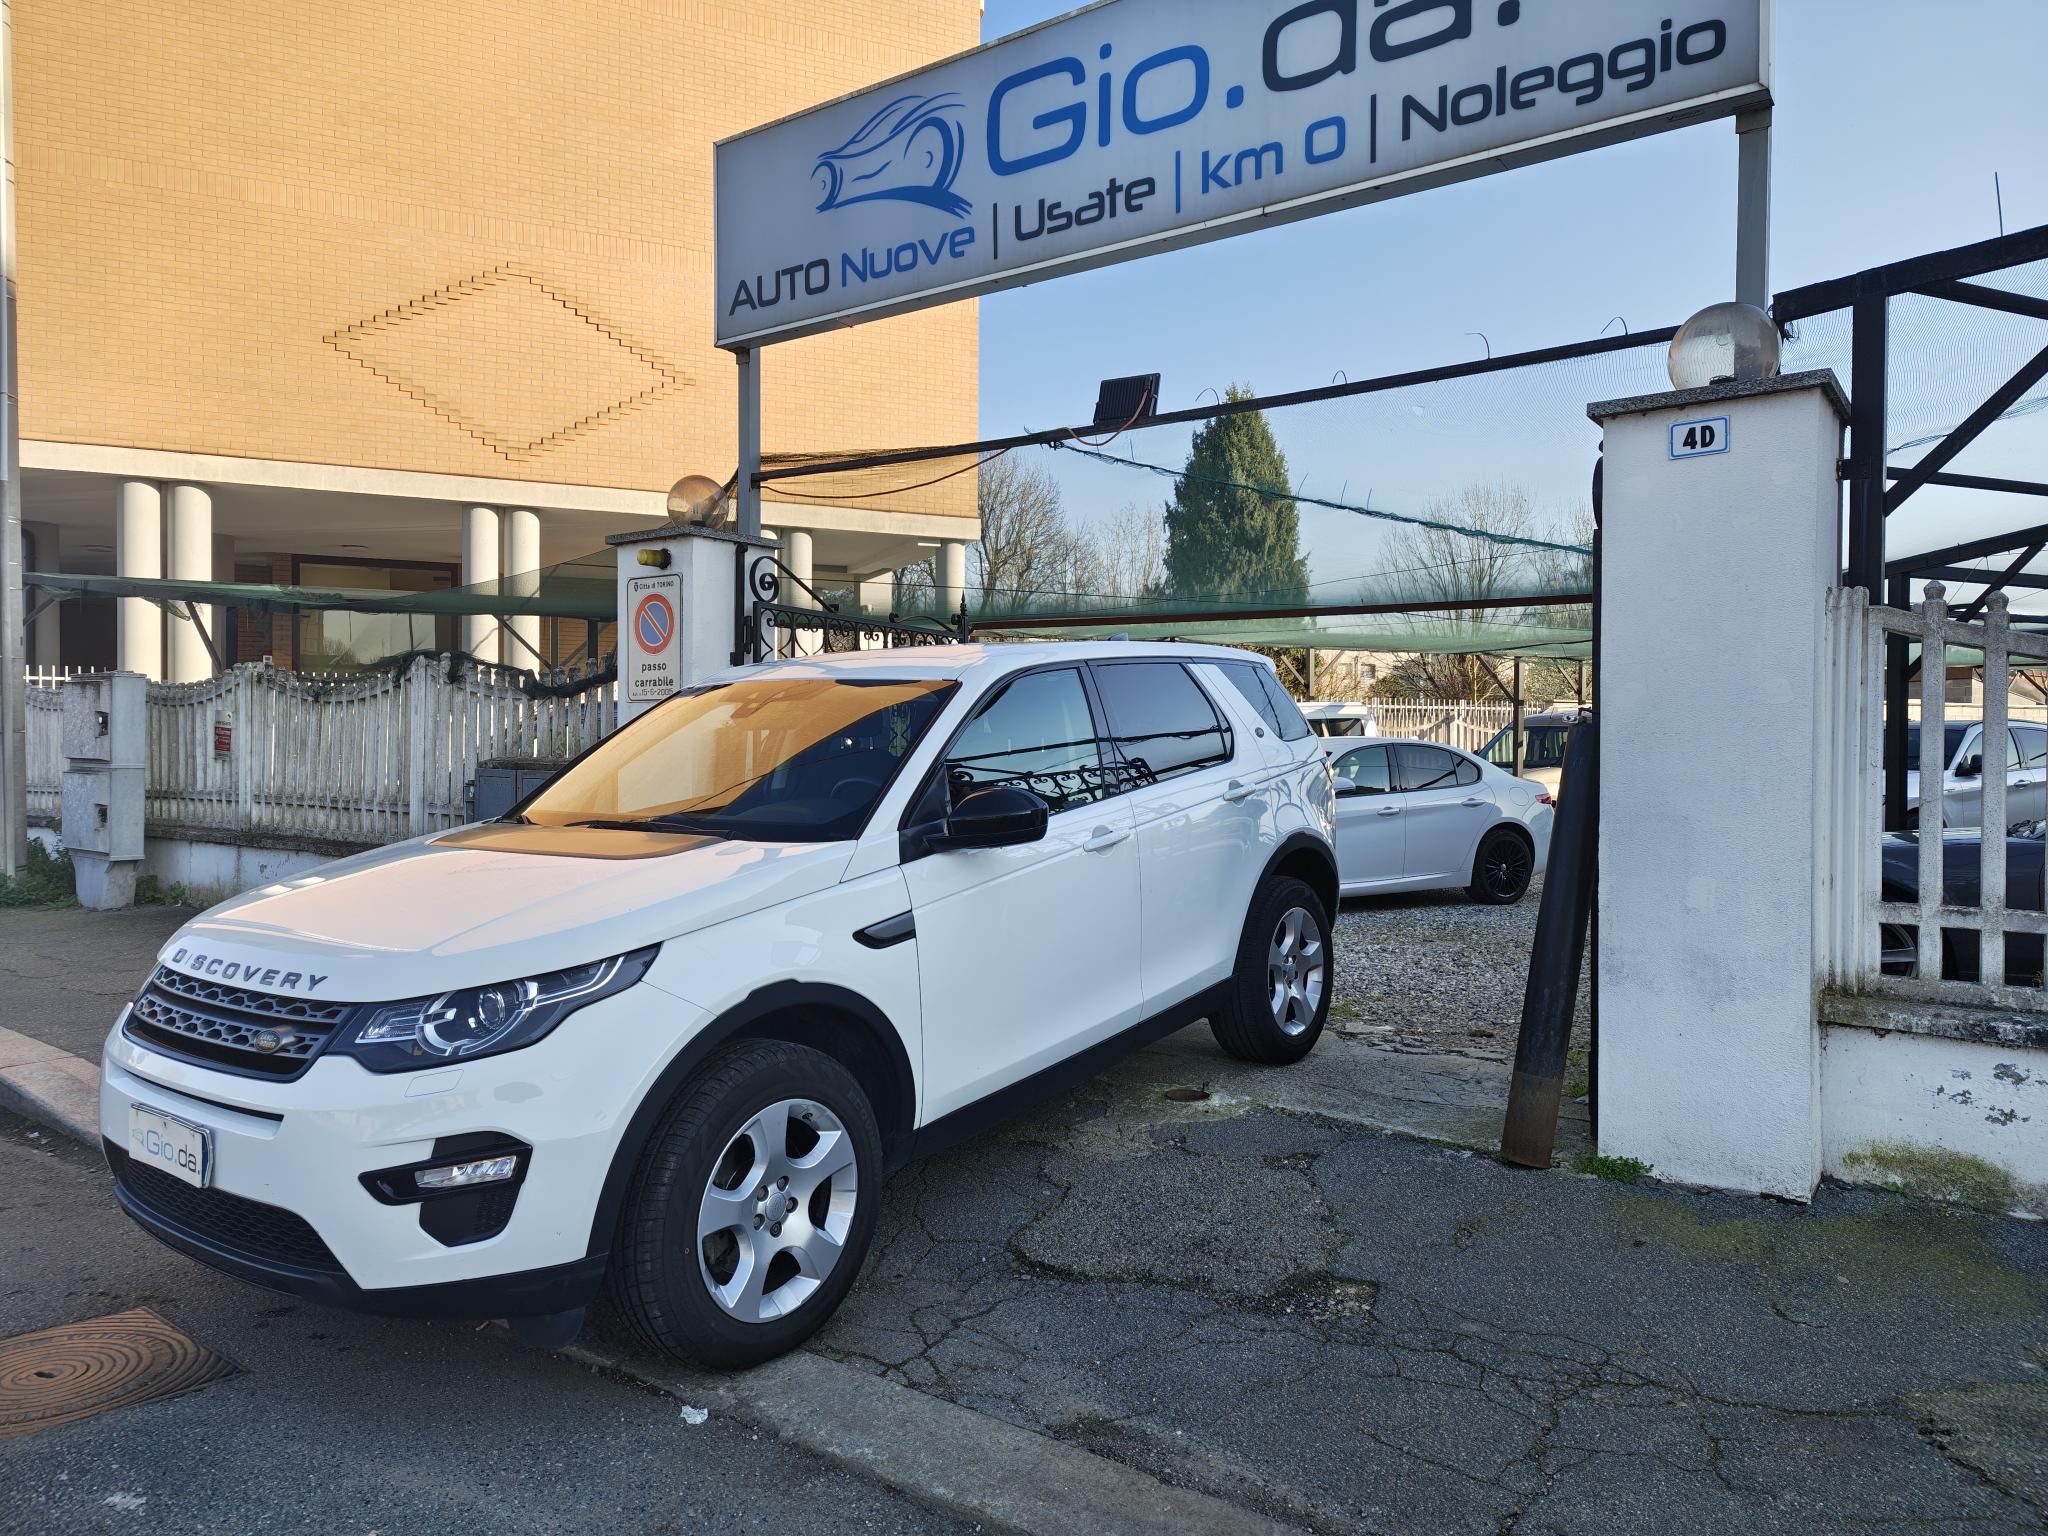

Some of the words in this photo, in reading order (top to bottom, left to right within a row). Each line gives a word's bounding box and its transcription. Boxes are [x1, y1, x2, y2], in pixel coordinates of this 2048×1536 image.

[728, 258, 830, 317] AUTO
[840, 224, 975, 288] Nuove
[1013, 176, 1156, 241] Usate
[1201, 141, 1284, 195] km
[1401, 18, 1727, 142] Noleggio
[1682, 425, 1716, 450] 4D
[641, 662, 667, 674] passo
[634, 676, 674, 687] carrabile
[171, 948, 329, 992] DISCOVERY
